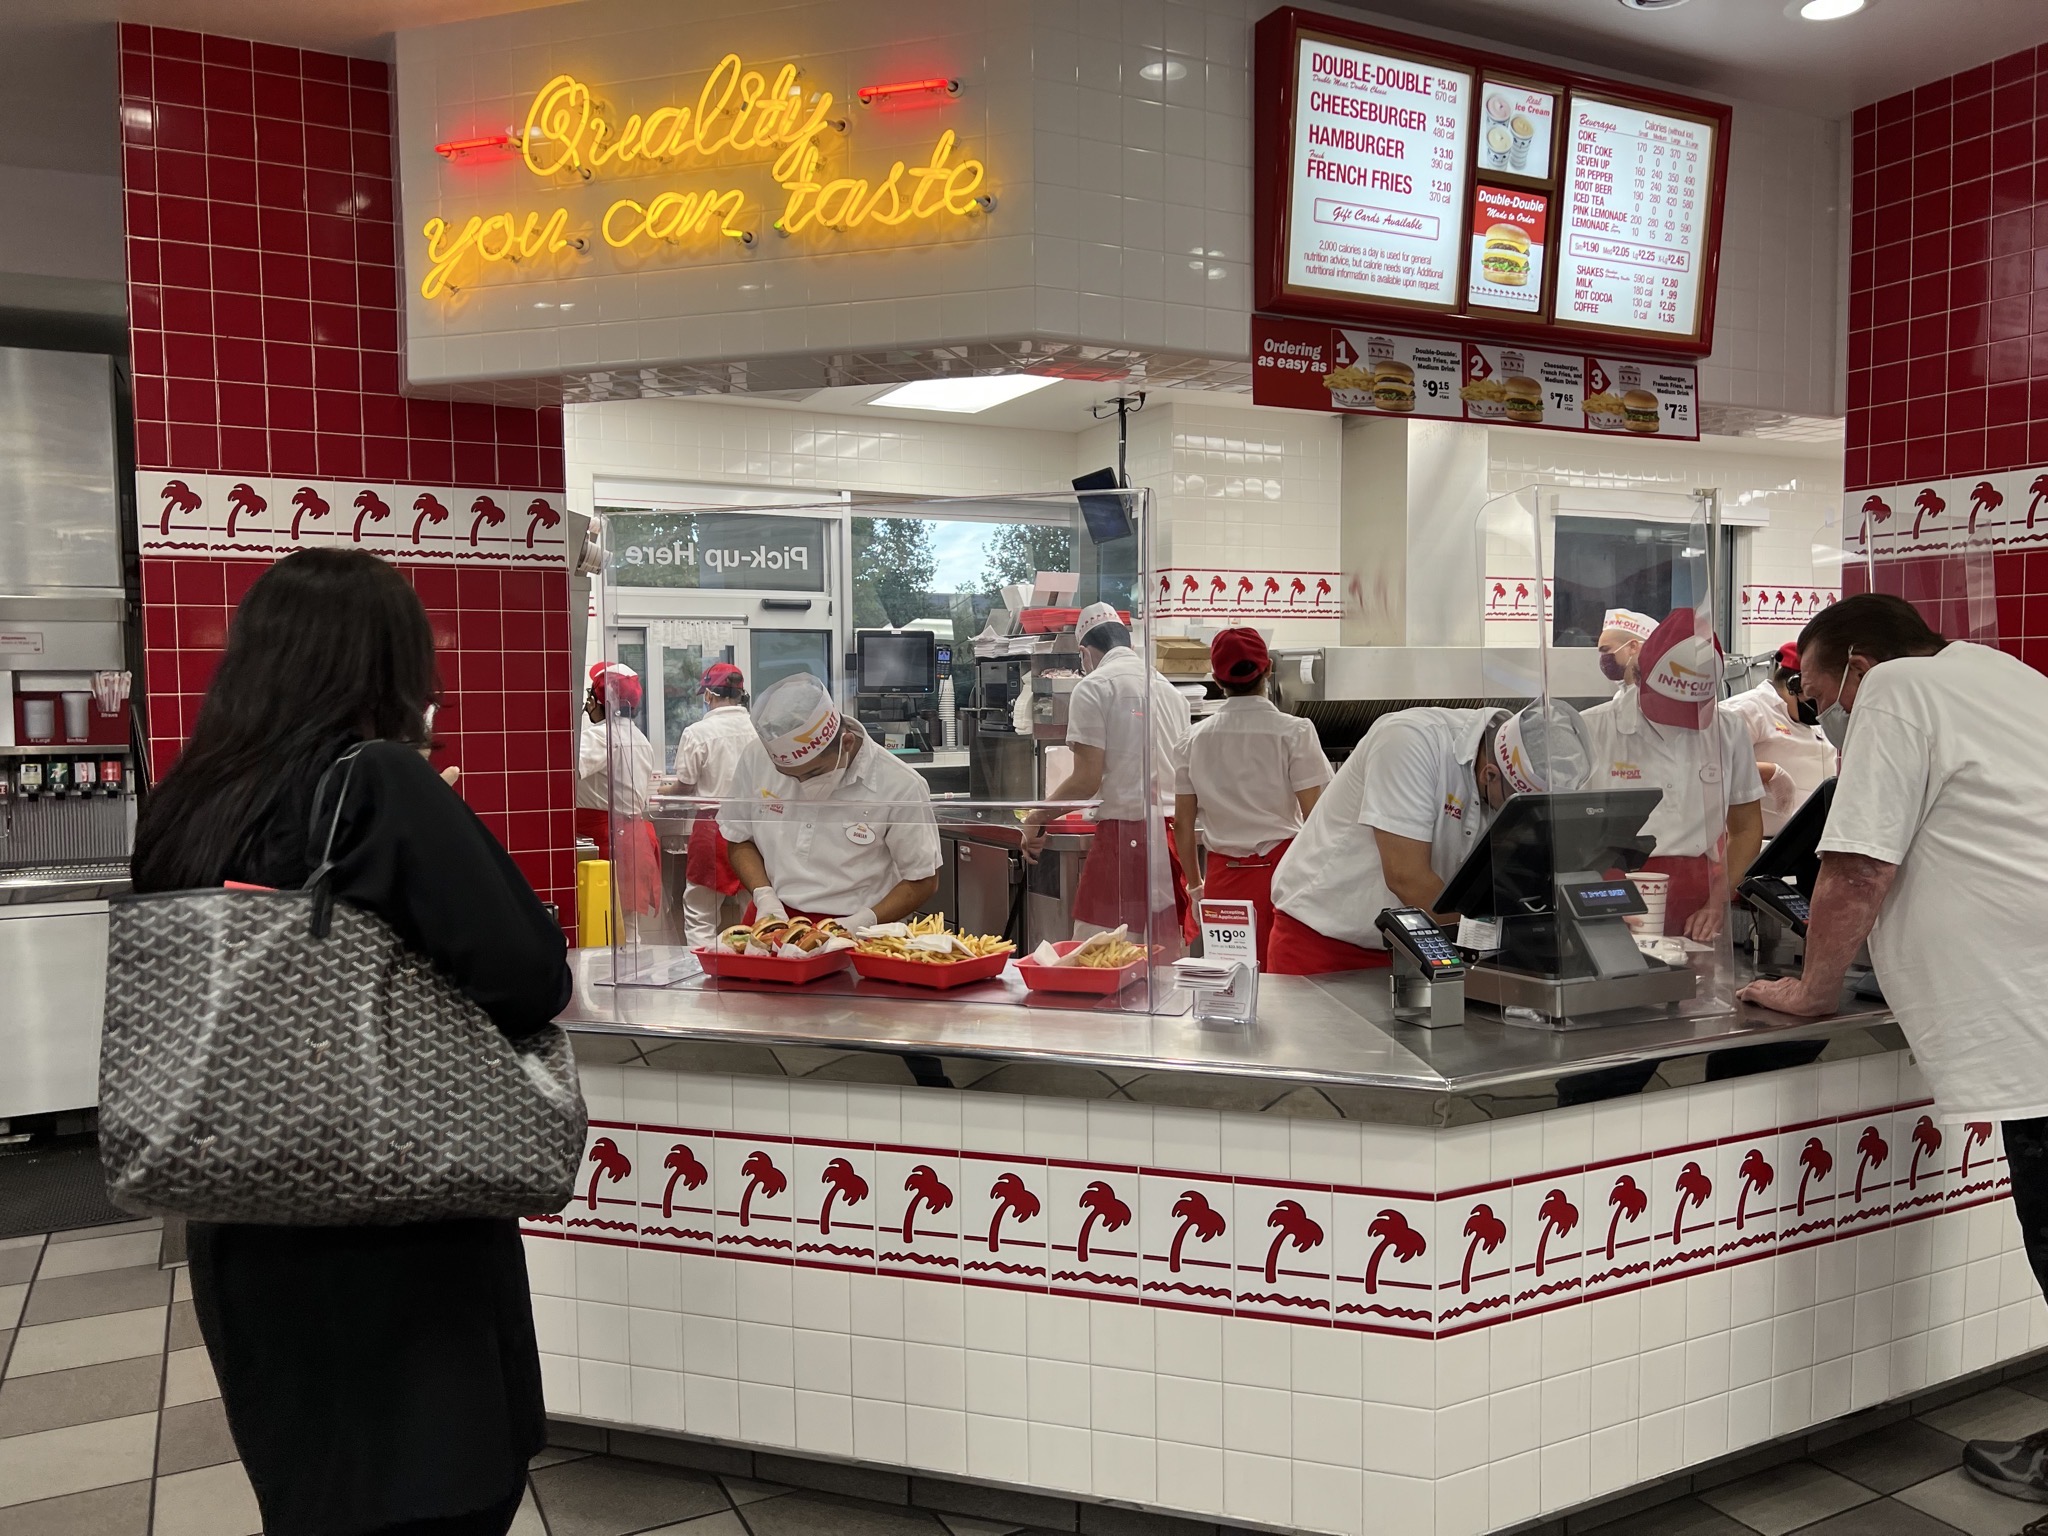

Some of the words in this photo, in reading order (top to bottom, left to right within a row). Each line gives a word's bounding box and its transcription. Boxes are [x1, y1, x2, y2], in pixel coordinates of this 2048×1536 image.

[1312, 53, 1432, 95] DOUBLE-DOUBLE
[1438, 79, 1457, 92] $5.00
[1350, 81, 1368, 91] Double
[1370, 86, 1387, 95] Cheese
[1435, 91, 1447, 101] 670
[1448, 93, 1456, 103] cal
[1526, 96, 1541, 105] Real
[522, 54, 833, 182] Quality
[1310, 91, 1426, 131] CHEESEBURGER
[1436, 115, 1455, 128] $3.50
[1515, 103, 1526, 112] Ice
[1527, 105, 1550, 116] Cream
[1579, 113, 1617, 133] Beverages
[1645, 120, 1667, 133] Calories
[1309, 124, 1404, 159] HAMBURGER
[1433, 128, 1445, 138] 480
[1446, 130, 1454, 140] cal
[1578, 130, 1596, 142] COKE
[1309, 149, 1325, 159] Fresh
[1577, 142, 1593, 154] DIET
[1595, 145, 1612, 158] COKE
[1431, 159, 1443, 169] 390
[1444, 161, 1452, 171] cal
[1576, 155, 1599, 168] SEVEN
[1601, 159, 1610, 169] UP
[1307, 159, 1367, 187] FRENCH
[1371, 170, 1413, 195] FRIES
[1576, 167, 1585, 178] DR
[1587, 170, 1613, 183] PEPPER
[1575, 180, 1593, 192] ROOT
[1595, 183, 1612, 195] BEER
[1430, 192, 1440, 202] 370
[1442, 194, 1450, 204] cal
[1479, 190, 1544, 212] Double-Double
[1574, 192, 1589, 203] ICED
[1591, 195, 1604, 206] TEA
[421, 209, 568, 299] you
[602, 188, 743, 247] can
[775, 130, 984, 233] taste
[1332, 206, 1352, 221] Gift
[1354, 209, 1380, 224] Cards
[1383, 215, 1422, 230] Available
[1487, 208, 1507, 219] Made
[1508, 211, 1514, 220] to
[1516, 213, 1535, 224] Order
[1573, 205, 1589, 216] PINK
[1591, 207, 1627, 222] LEMONADE
[1572, 217, 1609, 231] LEMONADE
[1352, 257, 1362, 267] but
[1368, 247, 1379, 259] day
[1577, 265, 1603, 277] SHAKES
[1646, 276, 1654, 285] cal
[1662, 277, 1678, 288] $2.80
[1576, 277, 1593, 288] MILK
[1645, 288, 1653, 296] cal
[1575, 289, 1588, 300] HOT
[1590, 291, 1612, 303] COCOA
[1660, 301, 1676, 312] $2.05
[1574, 301, 1599, 313] COFFEE
[1639, 311, 1647, 319] cal
[1264, 338, 1322, 360] Ordering
[1336, 341, 1349, 364] 1
[1258, 356, 1274, 367] as
[1277, 357, 1308, 373] easy
[1311, 361, 1327, 373] as
[1470, 355, 1484, 377] 2
[1591, 369, 1603, 390] 3
[791, 711, 837, 760] IN-N-OUT
